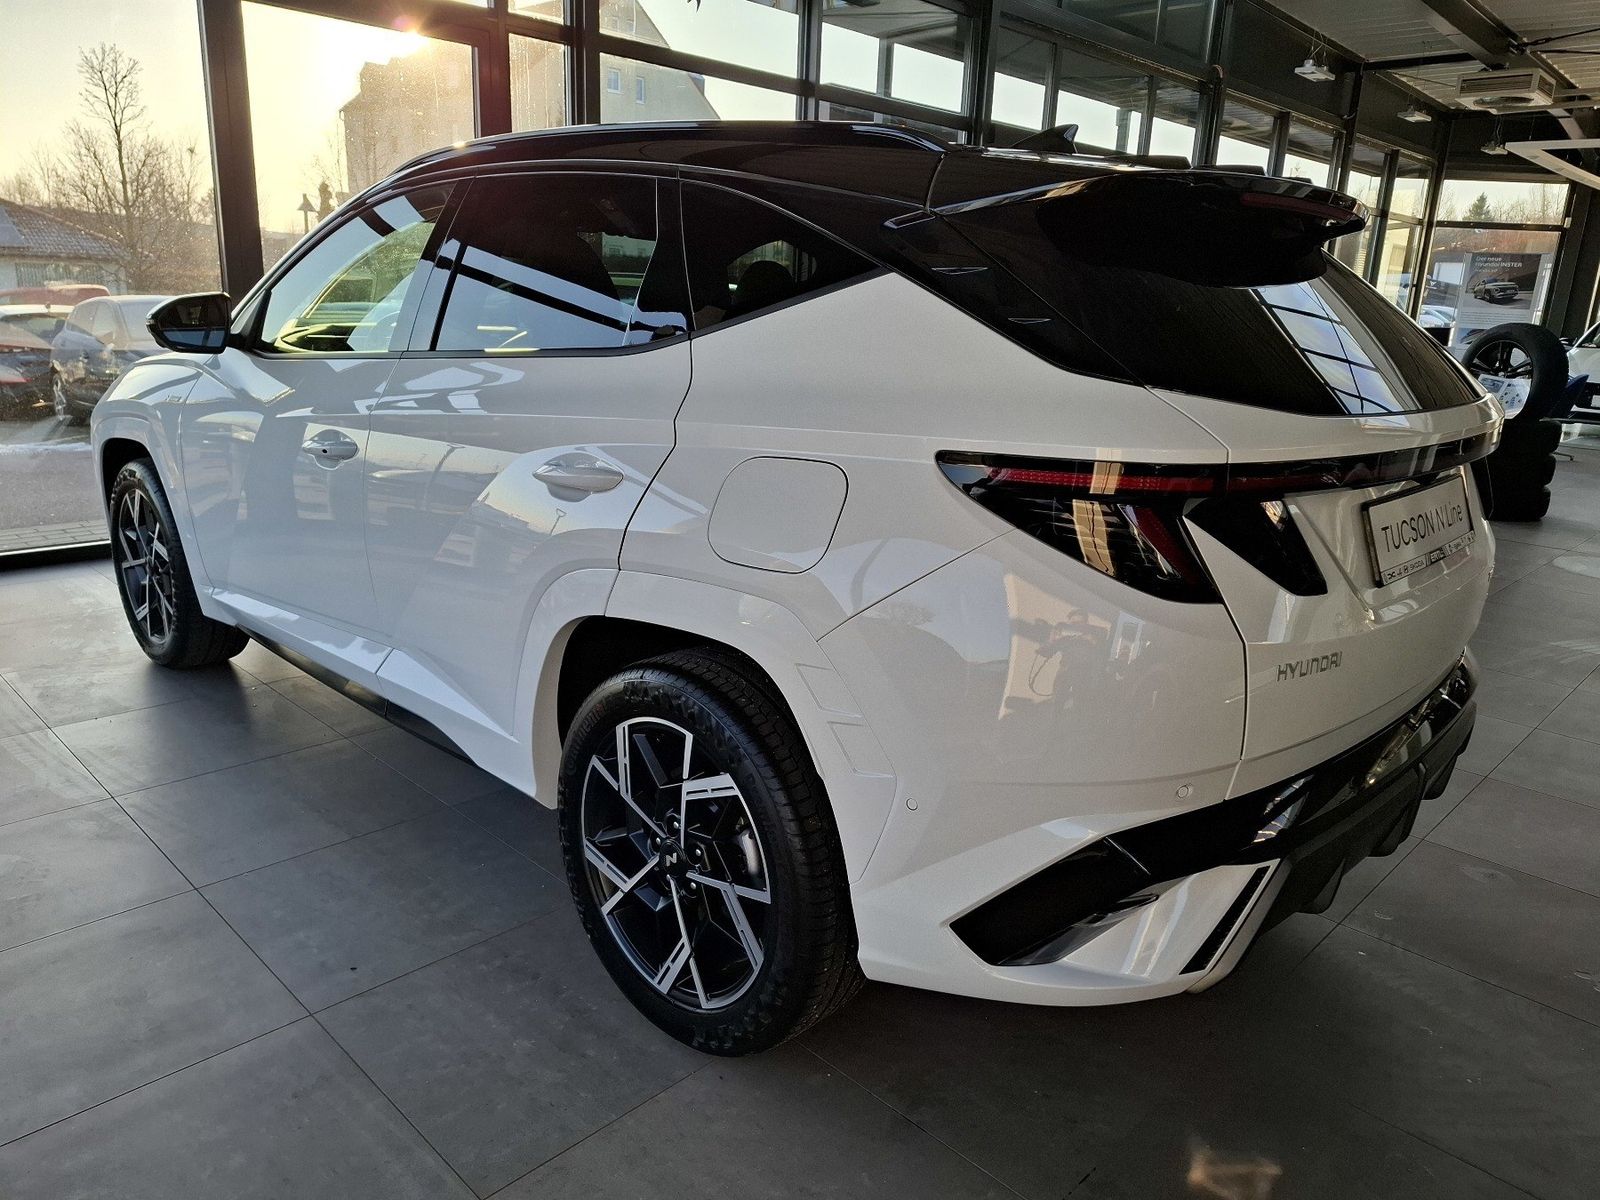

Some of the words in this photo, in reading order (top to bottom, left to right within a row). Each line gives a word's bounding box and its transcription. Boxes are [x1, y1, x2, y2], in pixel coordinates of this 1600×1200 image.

[1381, 510, 1435, 552] TUCSON
[1436, 506, 1445, 532] N
[1445, 501, 1463, 527] Line
[1277, 651, 1343, 681] HYUNDAI
[666, 852, 678, 867] N
